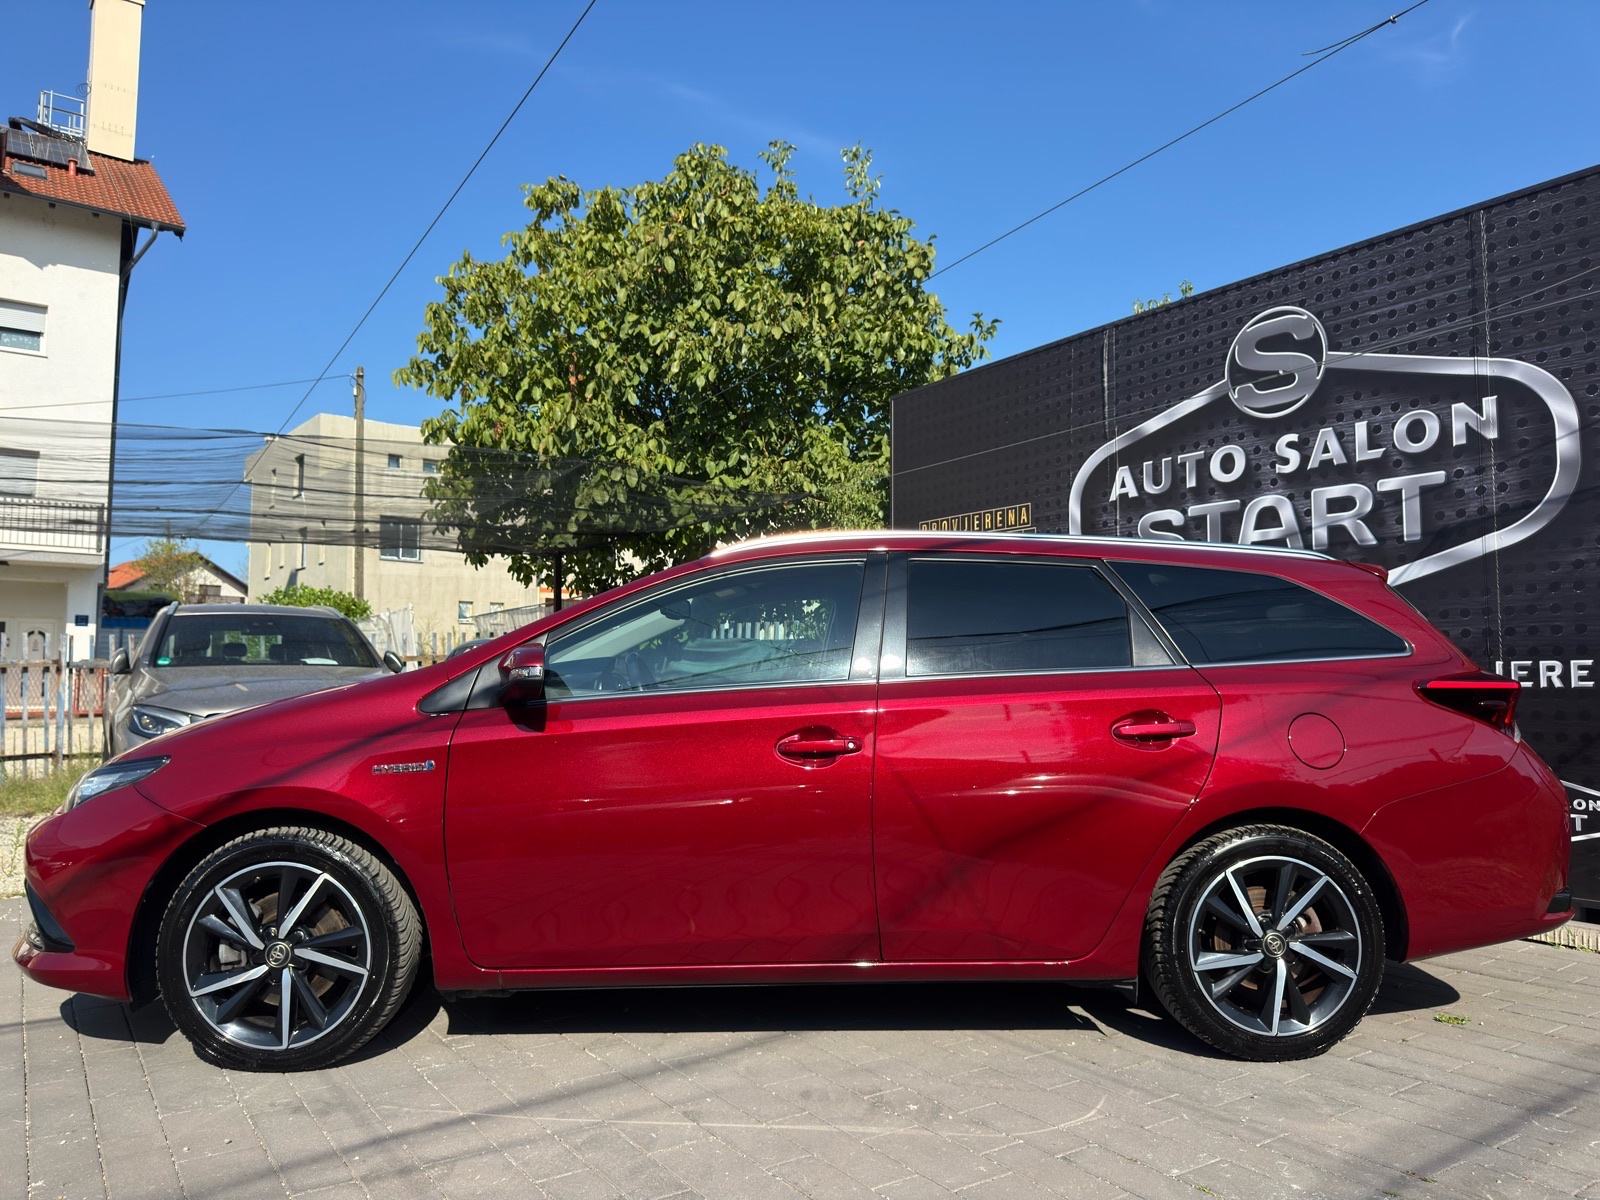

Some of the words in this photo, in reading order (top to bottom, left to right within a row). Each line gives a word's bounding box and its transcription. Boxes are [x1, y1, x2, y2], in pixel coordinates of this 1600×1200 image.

[1109, 444, 1246, 502] AUTO
[1275, 395, 1498, 474] SALON
[1138, 471, 1446, 551] START
